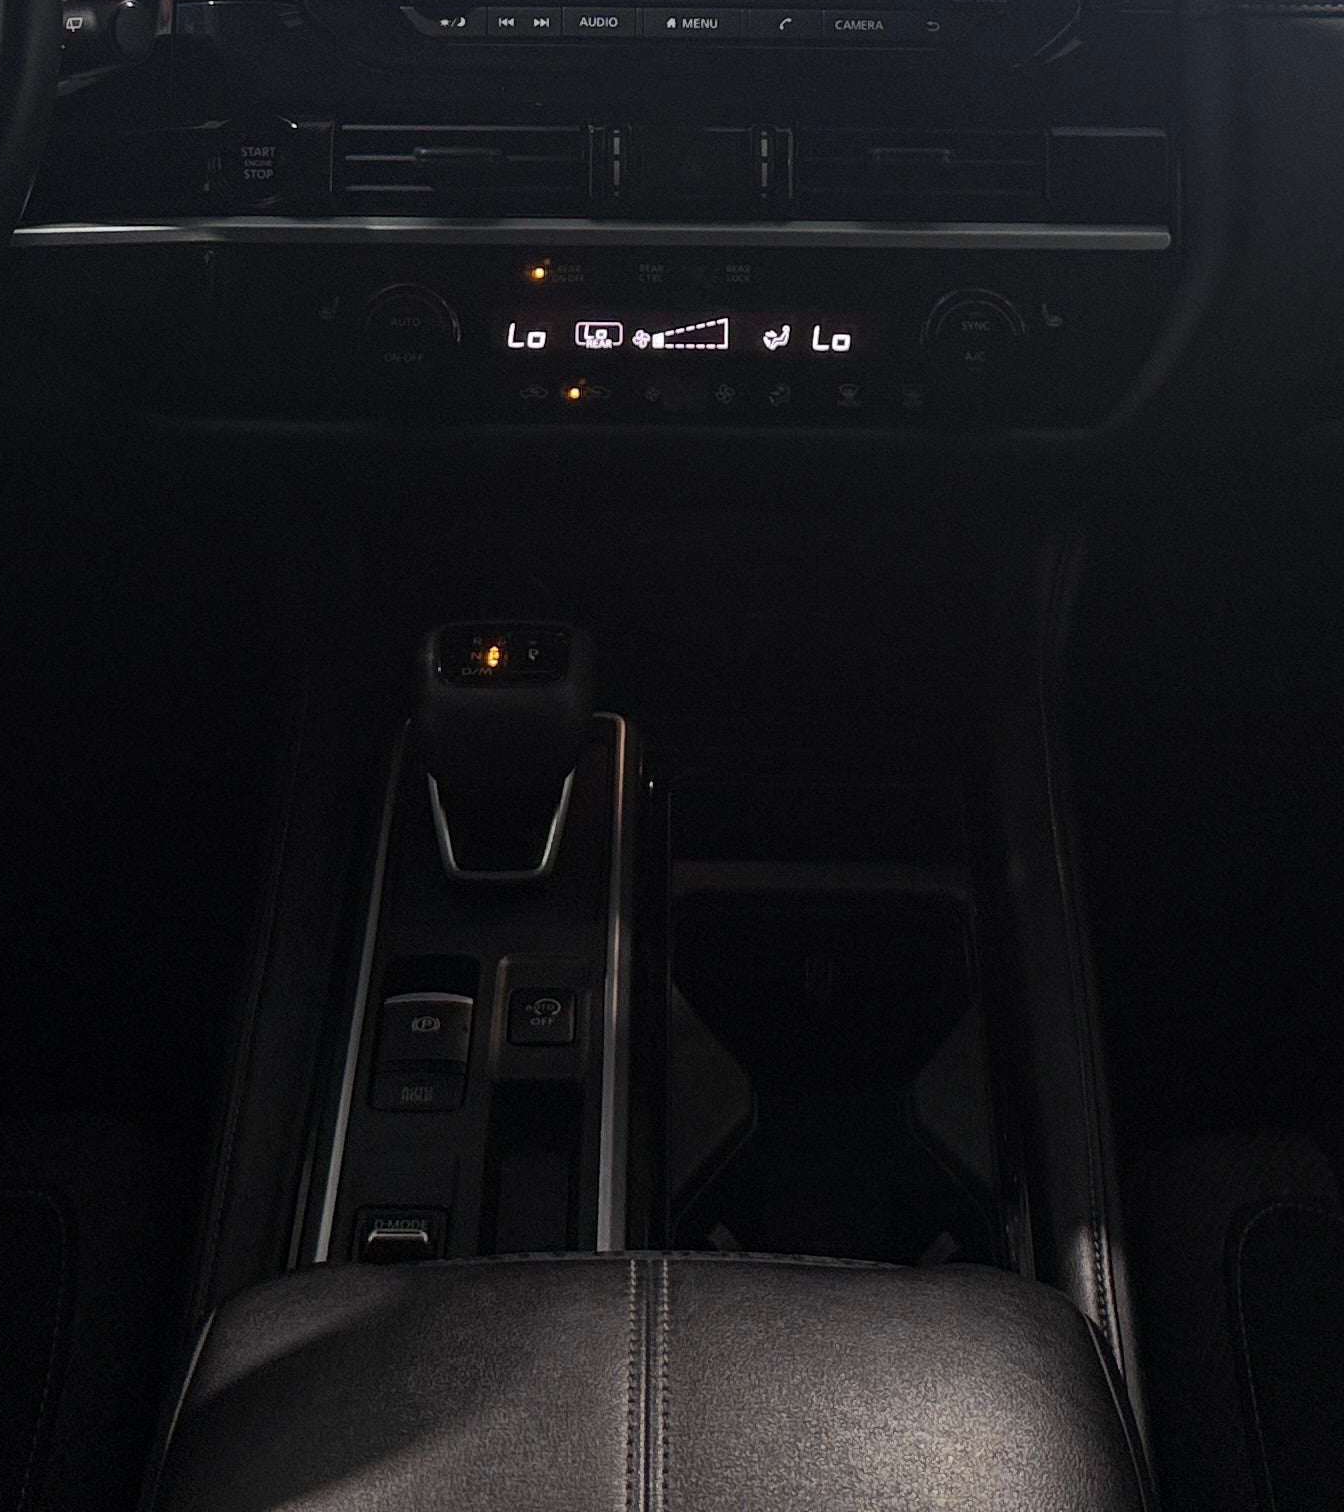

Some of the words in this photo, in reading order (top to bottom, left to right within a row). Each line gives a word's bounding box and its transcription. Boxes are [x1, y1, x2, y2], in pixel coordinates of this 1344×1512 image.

[579, 17, 619, 28] AUDIO
[682, 18, 719, 30] MENU
[835, 19, 885, 31] CAMERA
[240, 146, 276, 158] START
[243, 168, 274, 180] STOP
[507, 322, 547, 349] Lo
[812, 325, 852, 352] Lo
[586, 339, 613, 349] REAR
